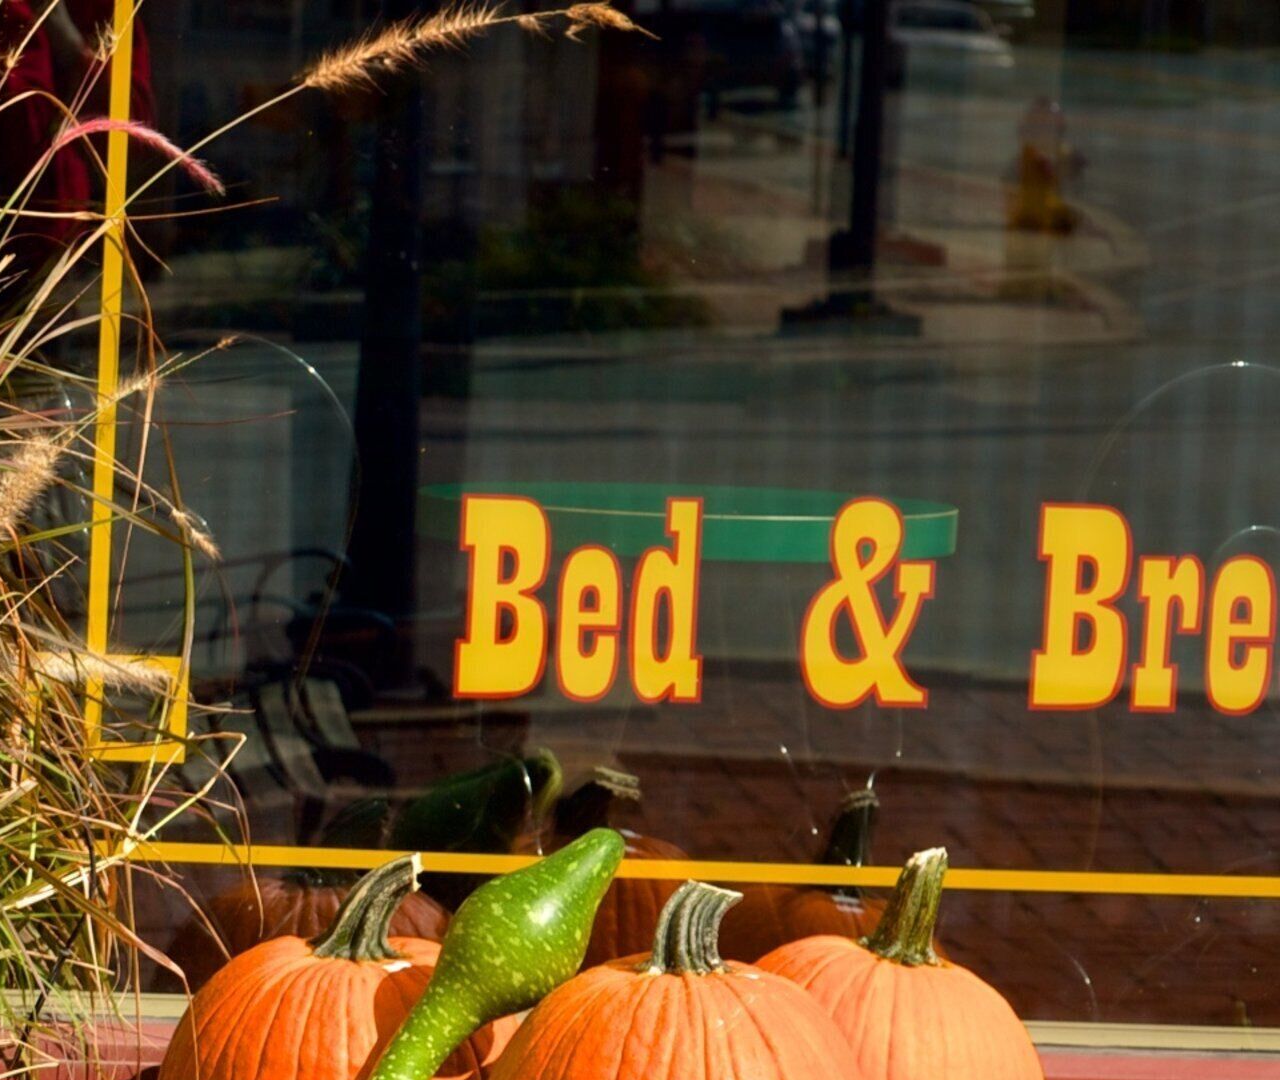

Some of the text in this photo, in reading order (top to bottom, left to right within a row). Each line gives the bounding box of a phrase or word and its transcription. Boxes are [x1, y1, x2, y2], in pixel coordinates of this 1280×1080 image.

[453, 493, 1278, 716] Bed & Bre
